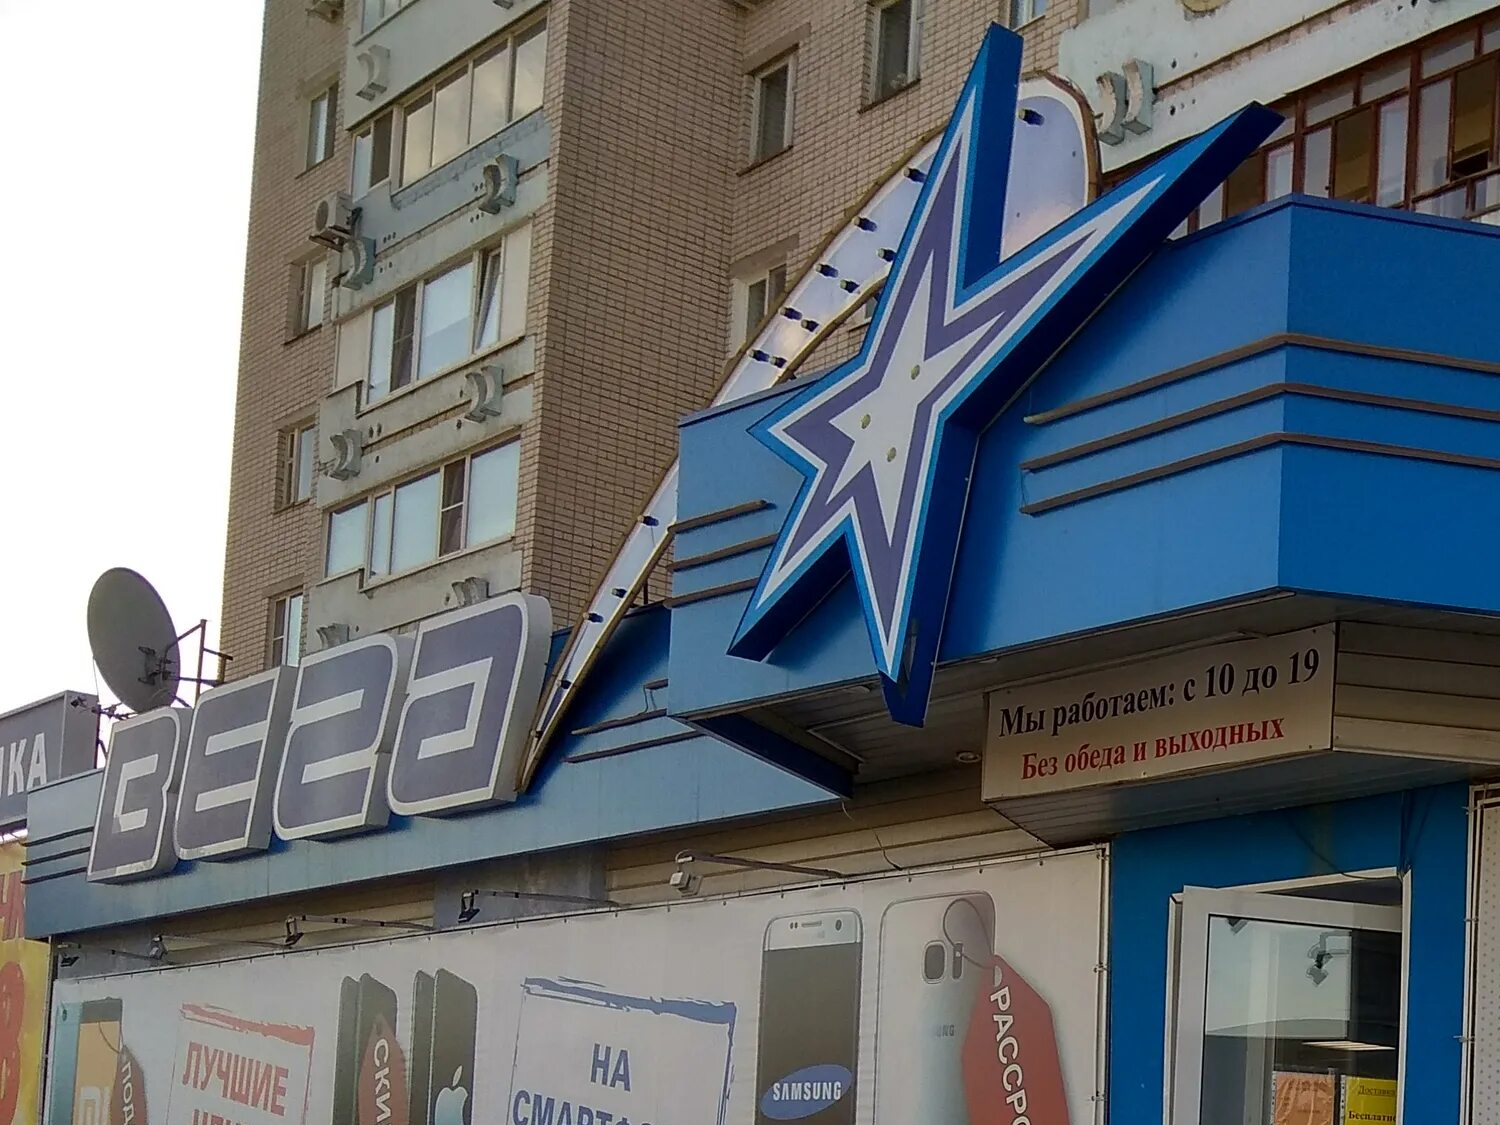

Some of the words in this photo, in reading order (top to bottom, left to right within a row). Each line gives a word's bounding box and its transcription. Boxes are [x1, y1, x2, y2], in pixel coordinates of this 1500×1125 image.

[998, 706, 1045, 738] Мы
[1051, 681, 1175, 736] работаем:
[1184, 677, 1195, 702] с
[1204, 662, 1236, 698] 10
[1242, 664, 1278, 696] до
[1287, 647, 1320, 685] 19
[0, 732, 48, 798] КА
[1021, 751, 1058, 780] Без
[1064, 742, 1126, 773] обеда
[1133, 740, 1146, 762] и
[1154, 717, 1285, 757] выходных
[181, 1040, 290, 1117] ЛУЧШИЕ
[590, 1042, 632, 1093] НА
[771, 1079, 843, 1103] SAMSUNG
